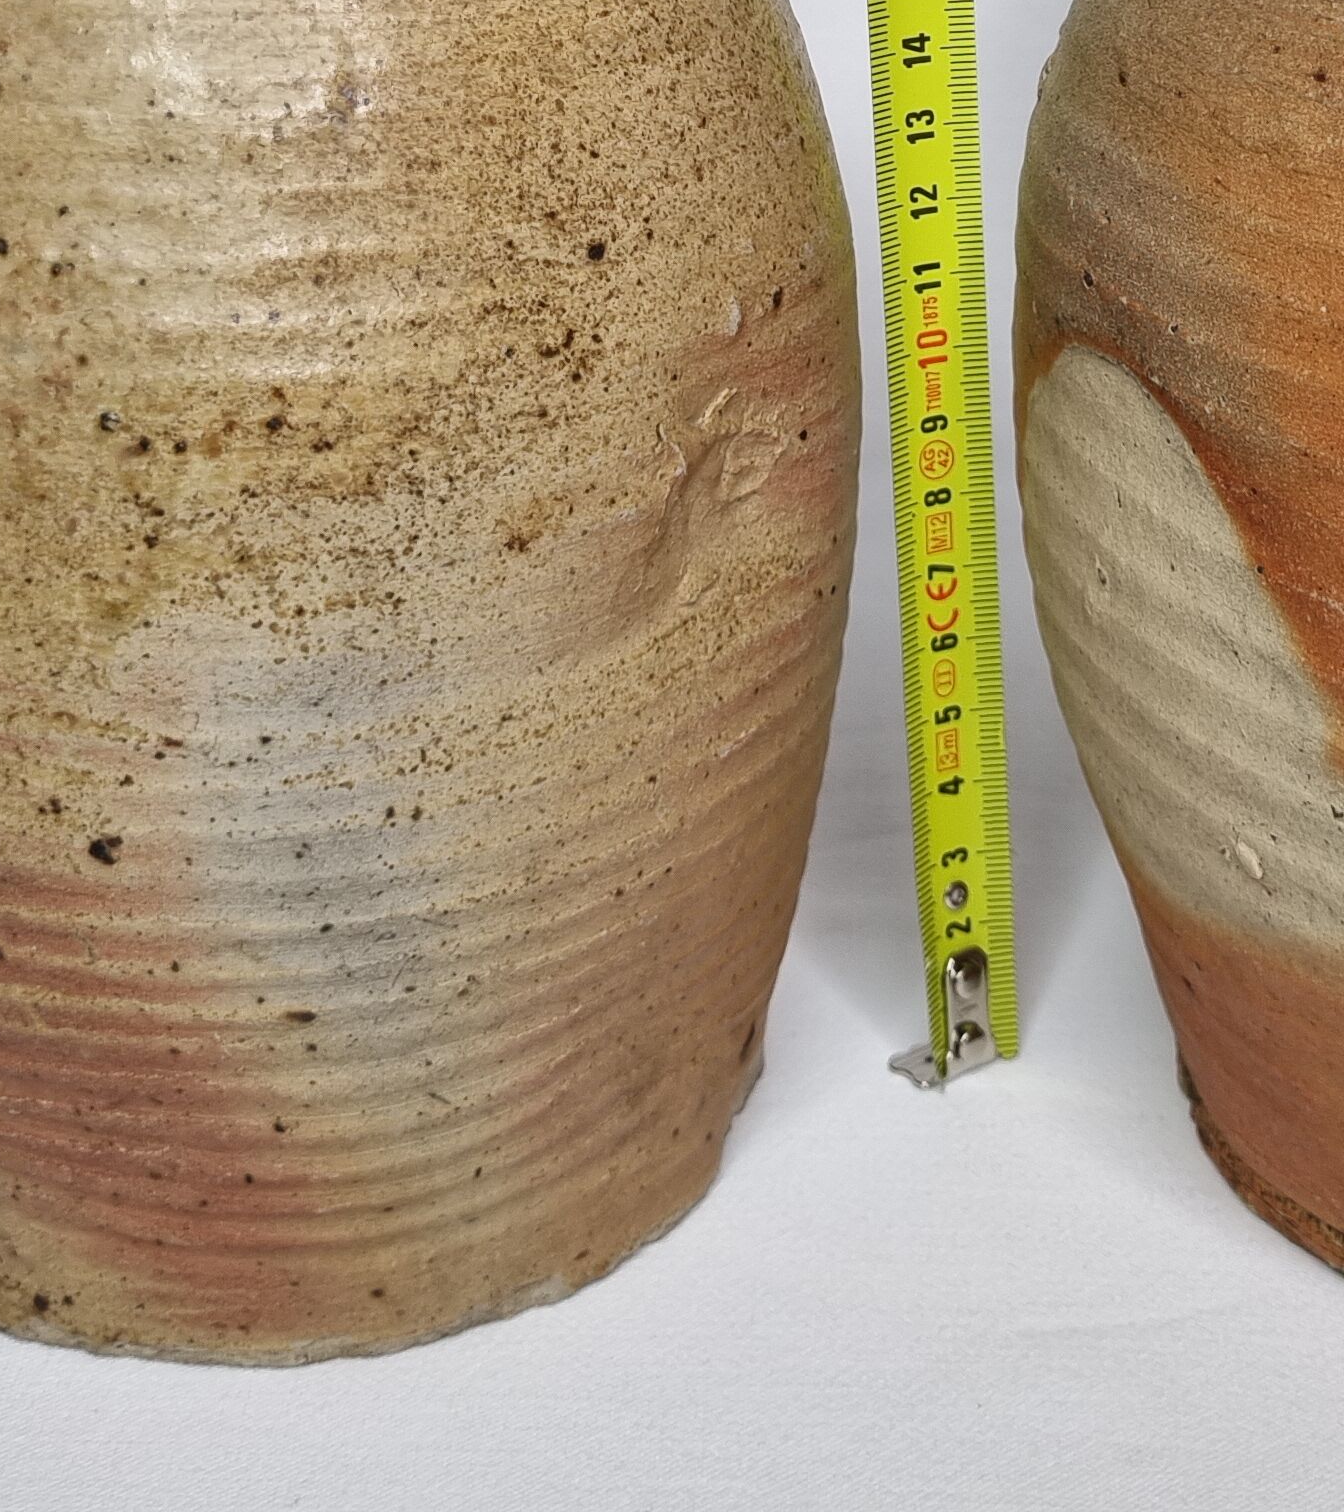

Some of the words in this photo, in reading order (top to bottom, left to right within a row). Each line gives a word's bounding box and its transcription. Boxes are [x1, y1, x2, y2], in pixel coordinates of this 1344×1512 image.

[901, 32, 933, 70] 14
[905, 109, 936, 146] 13
[909, 185, 939, 221] 12
[913, 262, 942, 295] 11
[916, 328, 948, 370] 10
[920, 414, 949, 434] 9
[923, 447, 936, 472] AG
[924, 487, 952, 508] 8
[928, 564, 955, 581] 7
[931, 632, 959, 653] 6
[934, 704, 962, 726] 5
[937, 775, 965, 796] 4
[941, 847, 969, 869] 3
[945, 916, 972, 940] 2
